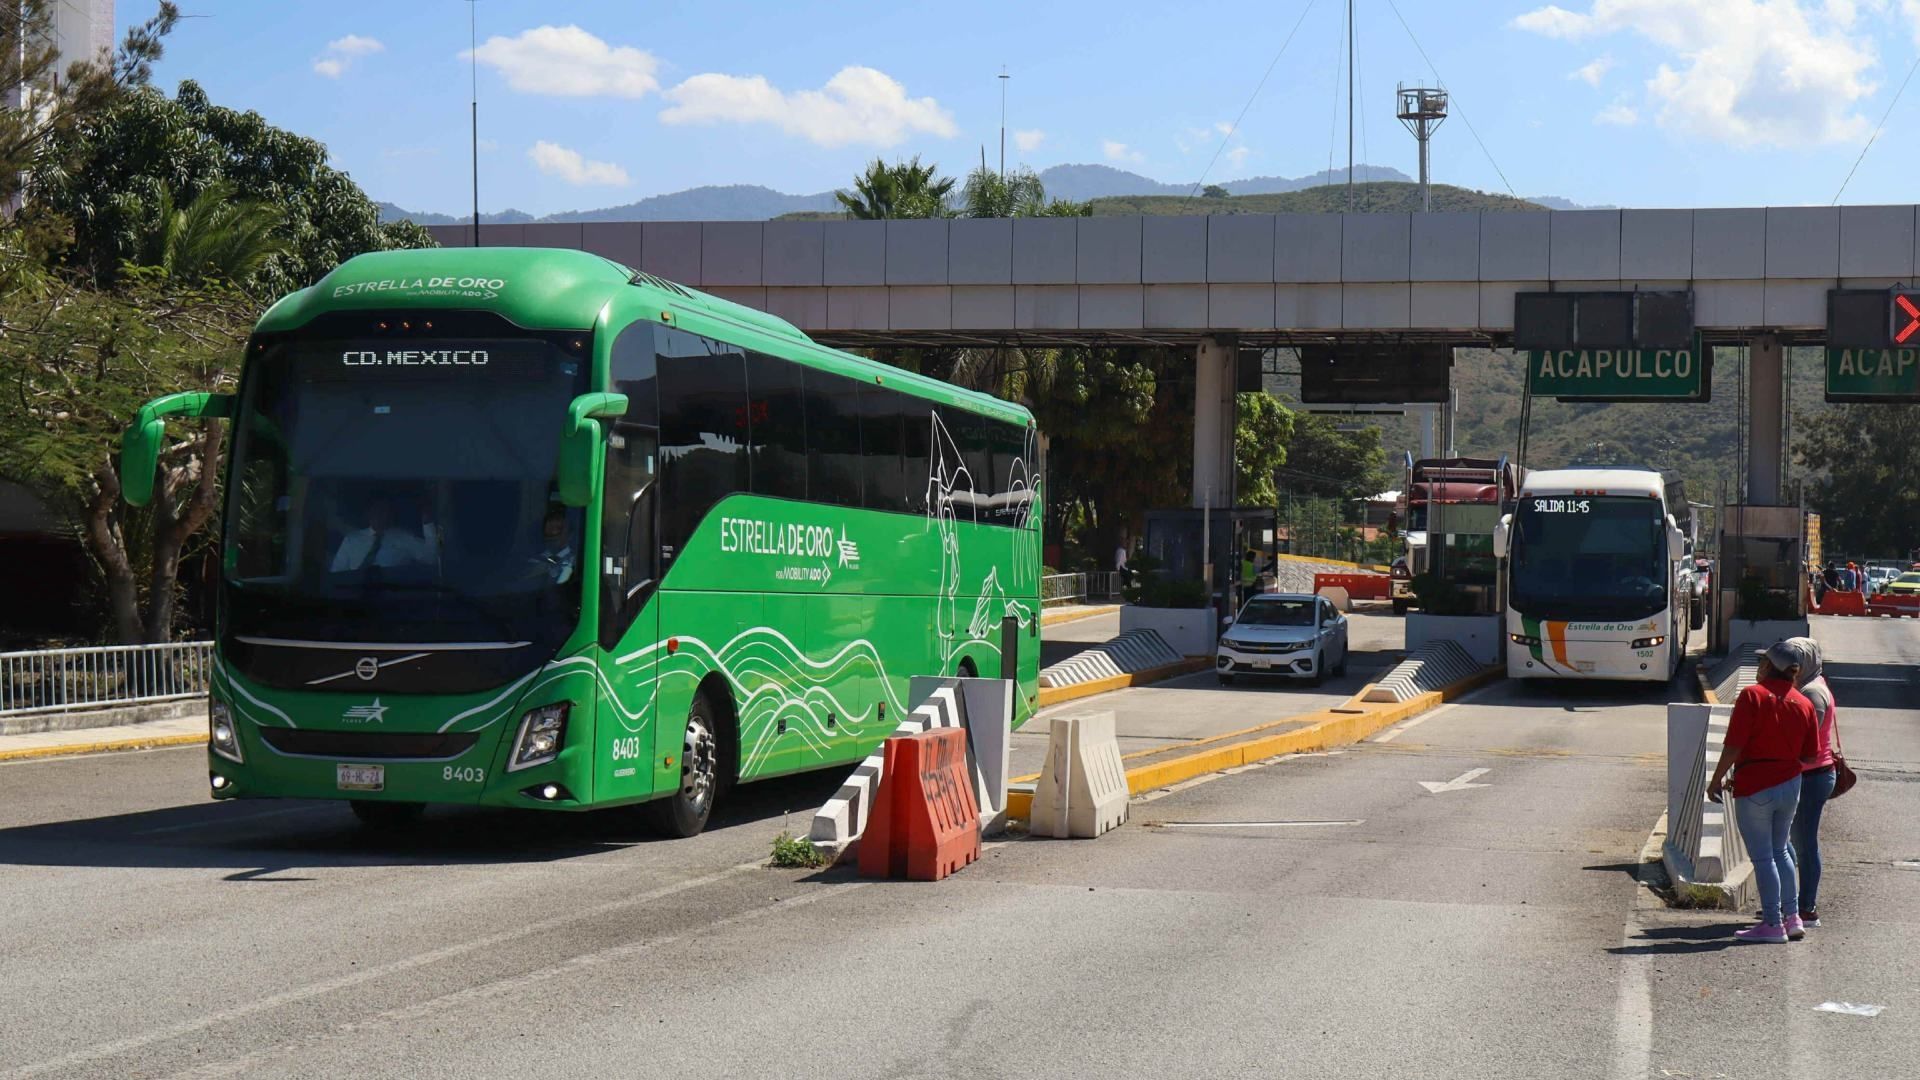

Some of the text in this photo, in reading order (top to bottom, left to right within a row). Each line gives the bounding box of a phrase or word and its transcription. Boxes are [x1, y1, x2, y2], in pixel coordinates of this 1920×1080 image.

[333, 278, 423, 298] ESTRELLA
[428, 277, 457, 288] DE
[458, 277, 505, 290] ORO
[1538, 350, 1691, 378] ACAPULCO
[1838, 349, 1920, 376] ACAP
[1534, 499, 1590, 513] SALIDA 11:45
[721, 517, 833, 558] ESTRELLA DE ORO
[1568, 623, 1634, 631] Estrella de Oro
[1637, 650, 1654, 658] 1502
[612, 736, 639, 761] 8403
[442, 765, 484, 783] 8403
